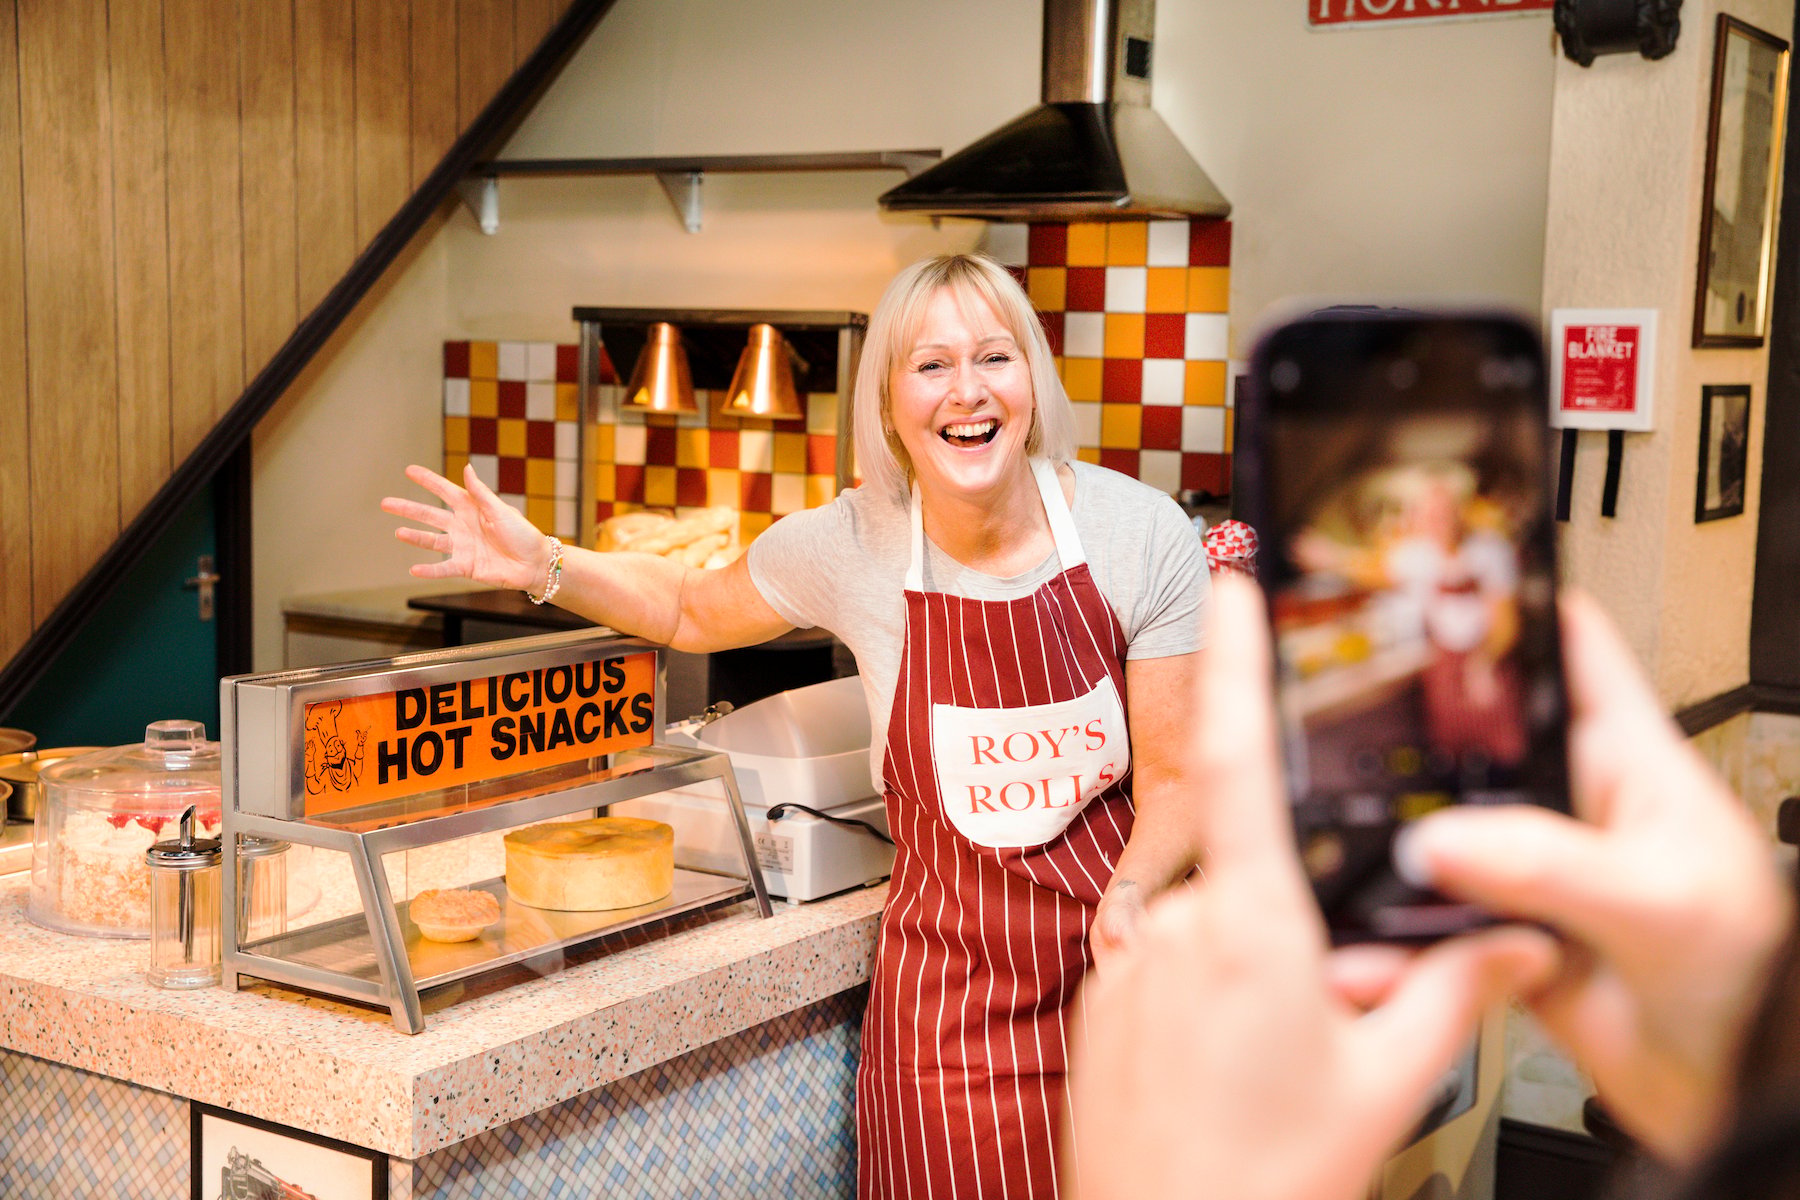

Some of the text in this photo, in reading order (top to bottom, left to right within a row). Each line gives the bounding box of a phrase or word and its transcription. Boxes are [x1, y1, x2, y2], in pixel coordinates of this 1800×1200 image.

[1567, 341, 1634, 359] BLANKET
[1585, 326, 1618, 342] FIRE
[395, 656, 626, 731] DELICIOUS
[378, 692, 653, 784] HOT SNACKS
[968, 718, 1106, 765] ROY'S
